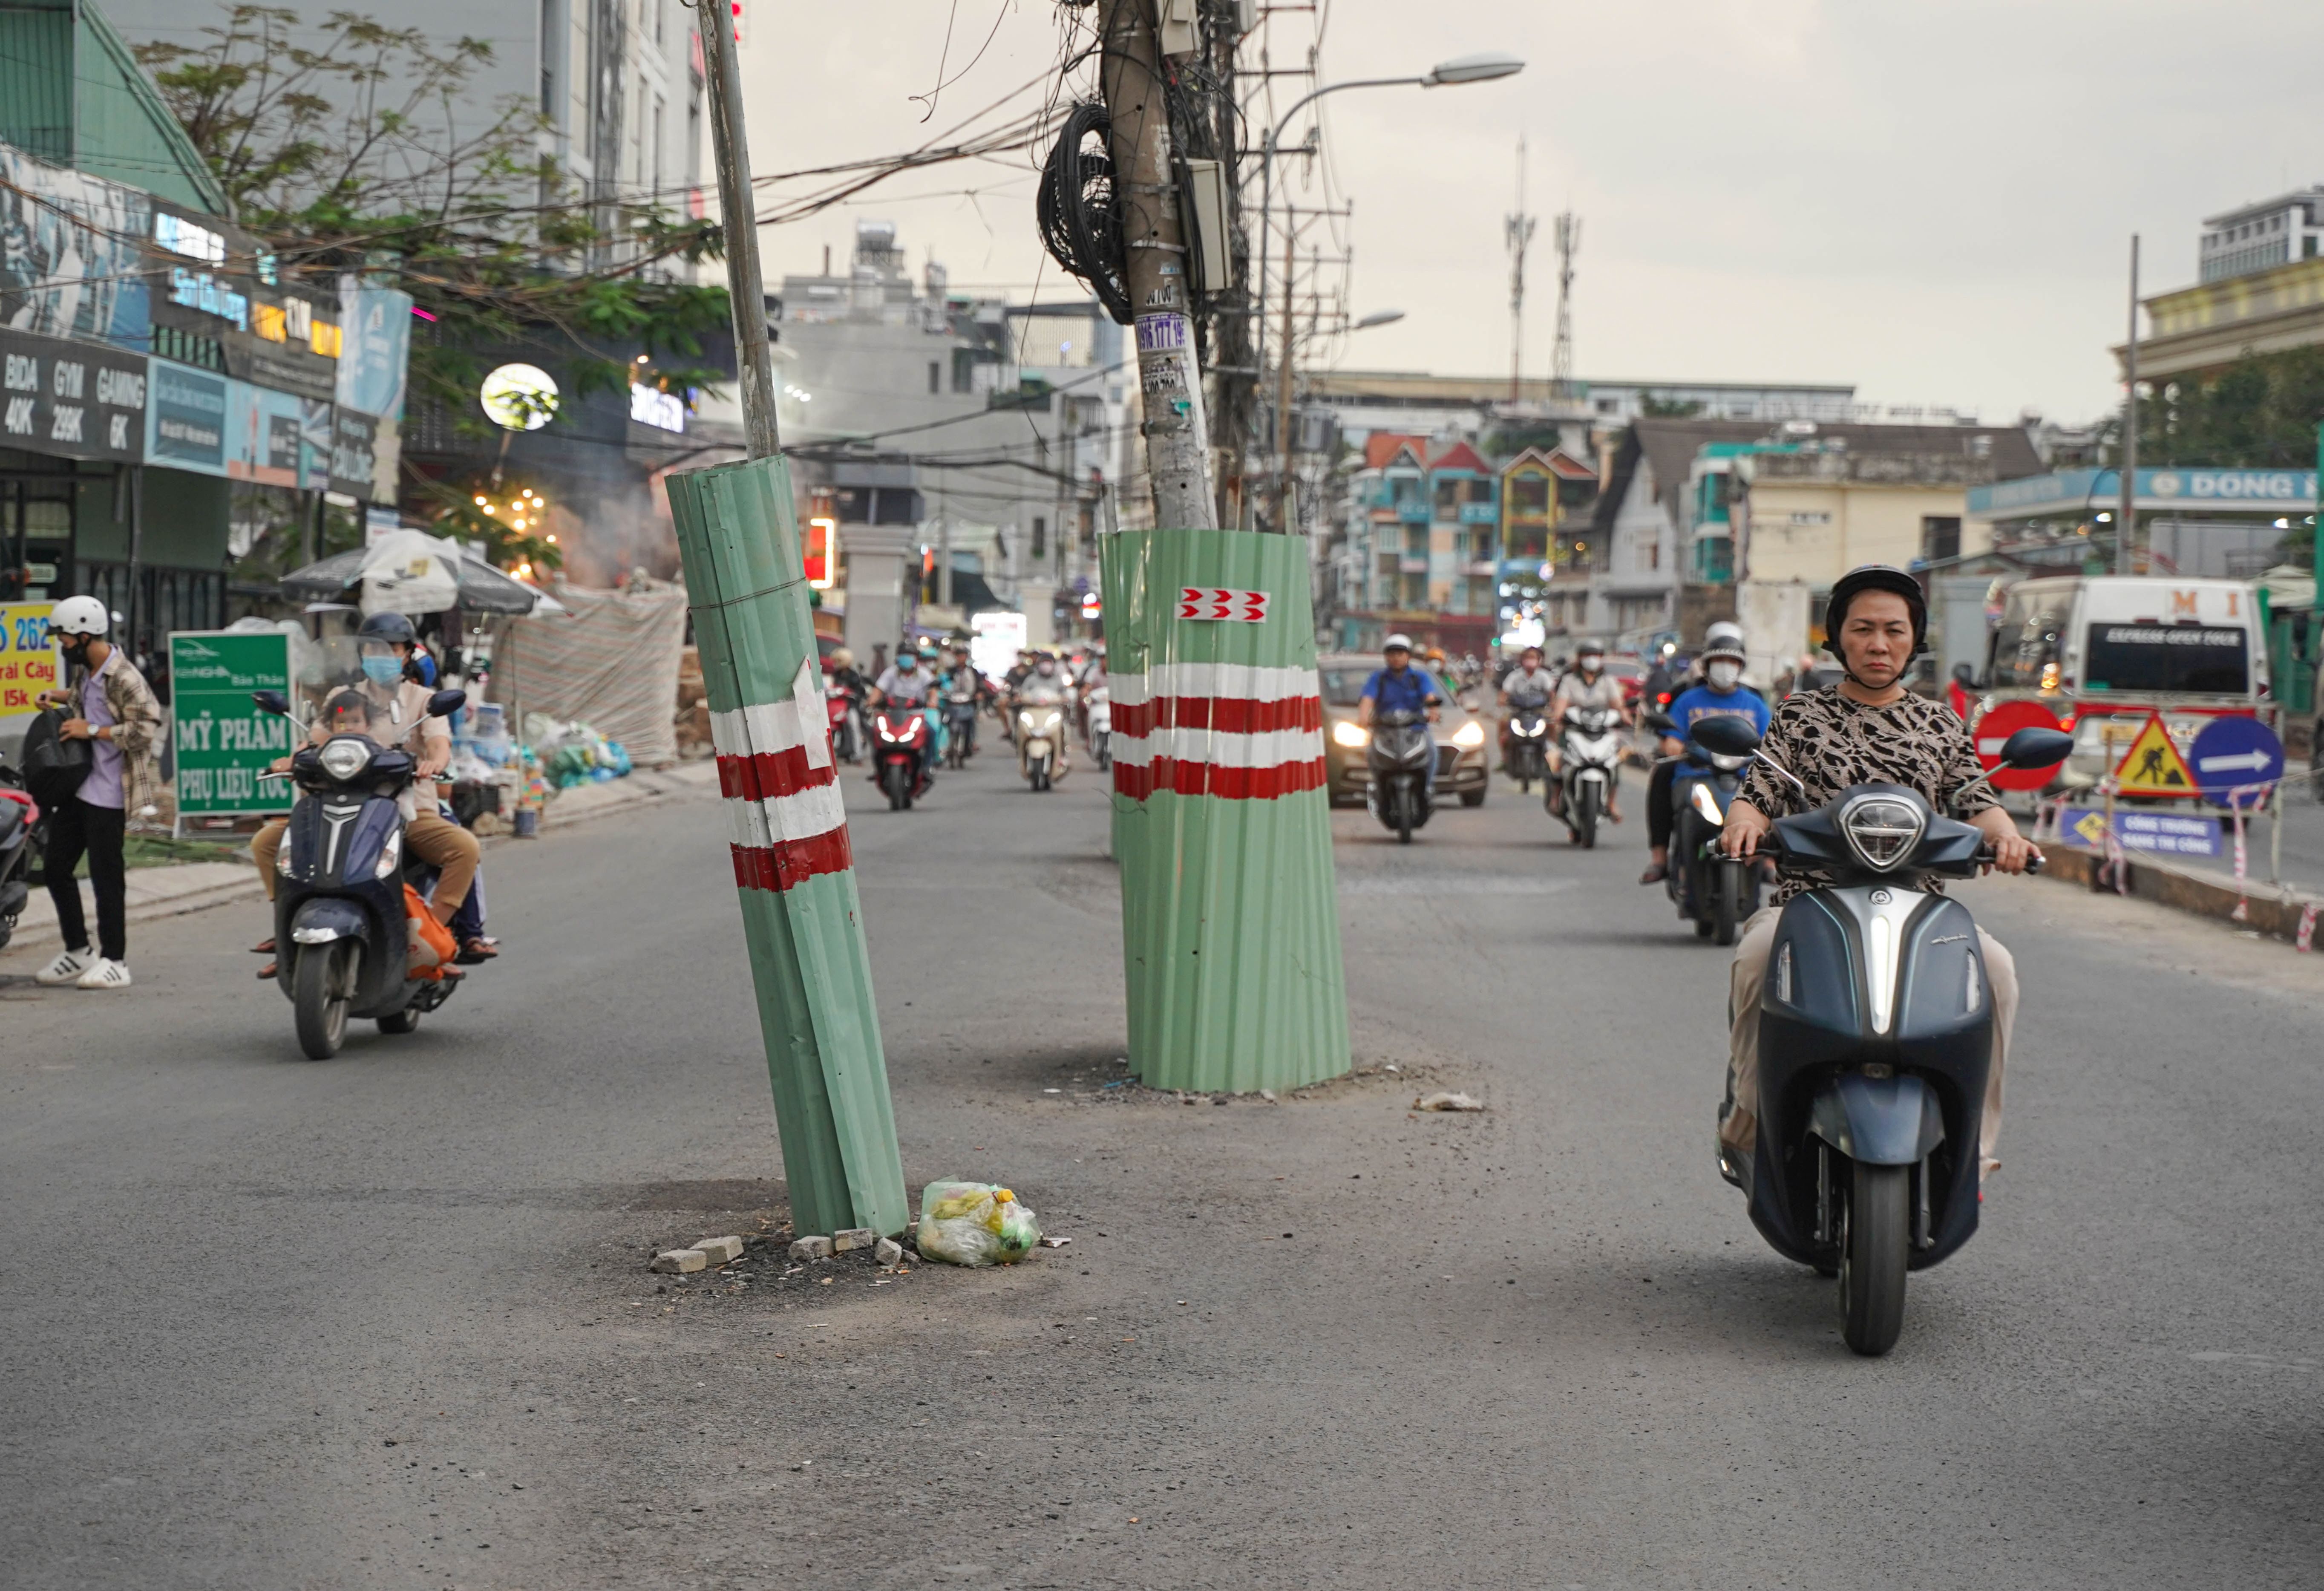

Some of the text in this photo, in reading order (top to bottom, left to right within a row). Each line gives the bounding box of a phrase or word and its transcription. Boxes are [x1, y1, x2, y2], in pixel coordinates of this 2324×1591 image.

[4, 353, 38, 392] BIDA
[53, 359, 84, 399] GYM
[96, 366, 145, 409] GAMING
[16, 617, 51, 651] 262
[24, 661, 55, 682] Cây
[4, 689, 29, 707] 15k
[178, 709, 214, 751] MỸ
[180, 769, 213, 809] PHỤ
[216, 758, 253, 809] LIỆU
